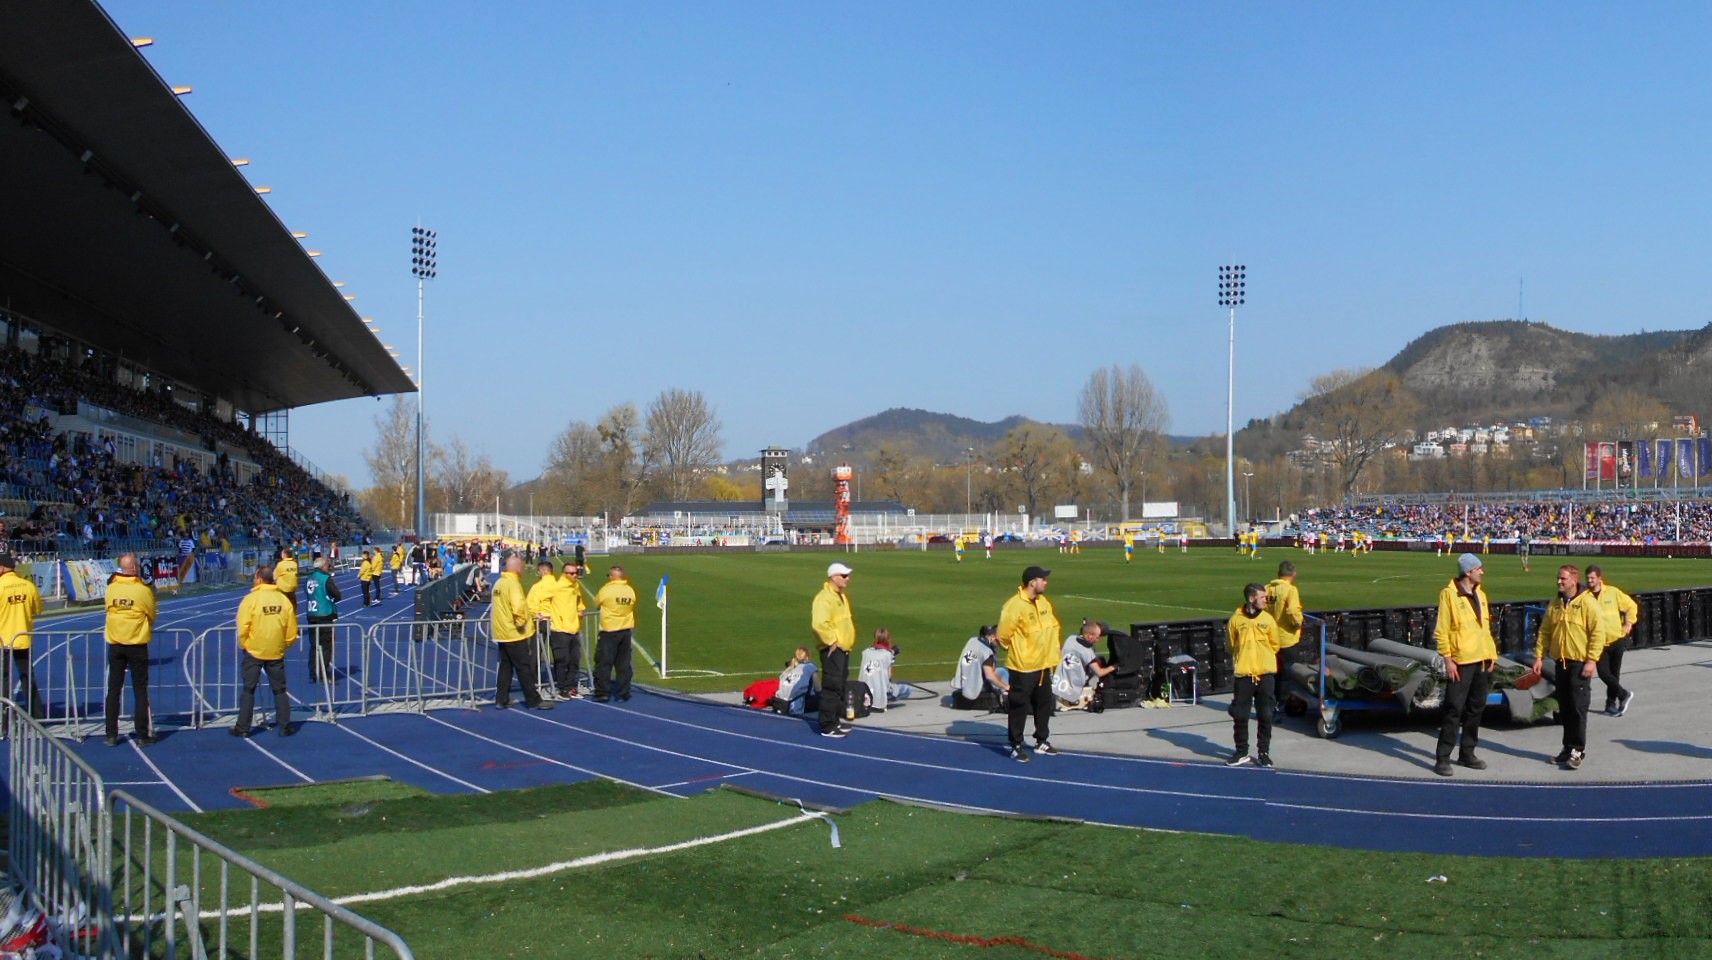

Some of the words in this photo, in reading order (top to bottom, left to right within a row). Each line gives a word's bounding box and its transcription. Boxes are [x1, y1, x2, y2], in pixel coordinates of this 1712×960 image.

[8, 594, 27, 603] ERJ
[112, 598, 134, 606] ERJ
[262, 605, 282, 614] ERJ
